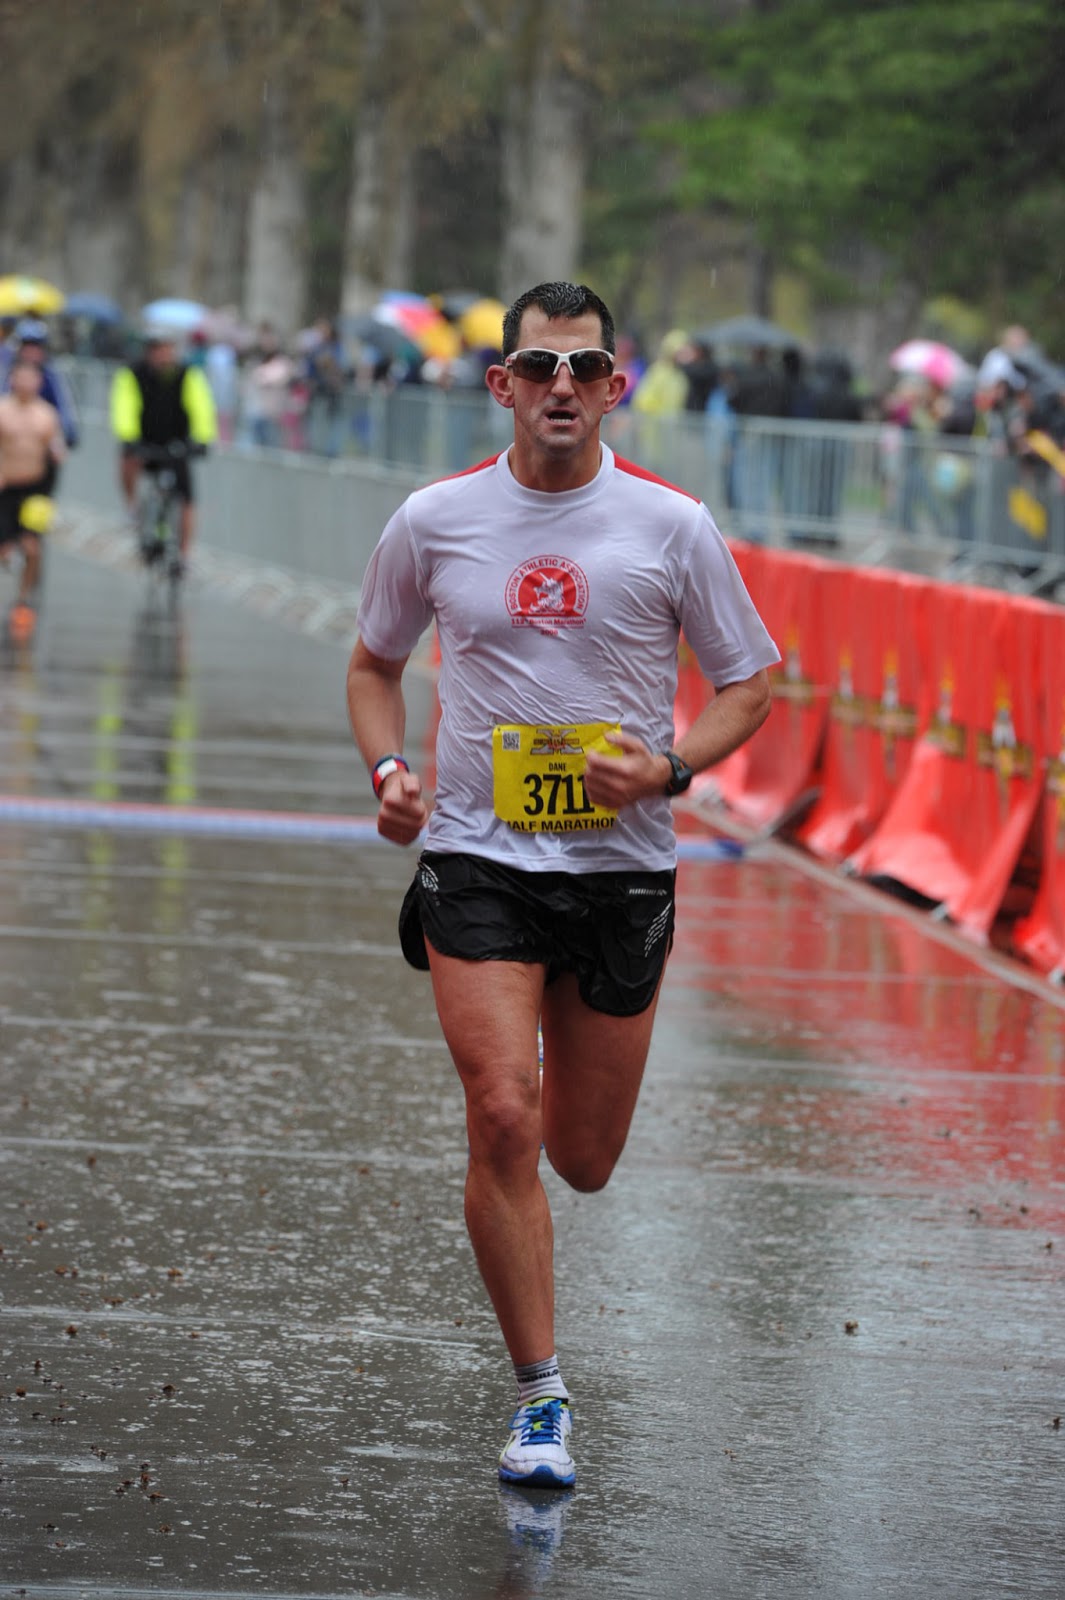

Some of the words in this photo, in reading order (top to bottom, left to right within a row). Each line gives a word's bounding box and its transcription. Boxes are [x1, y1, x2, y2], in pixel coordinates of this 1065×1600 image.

[519, 559, 558, 577] ATHLETIC
[548, 763, 567, 772] DANE
[523, 773, 595, 815] 3711
